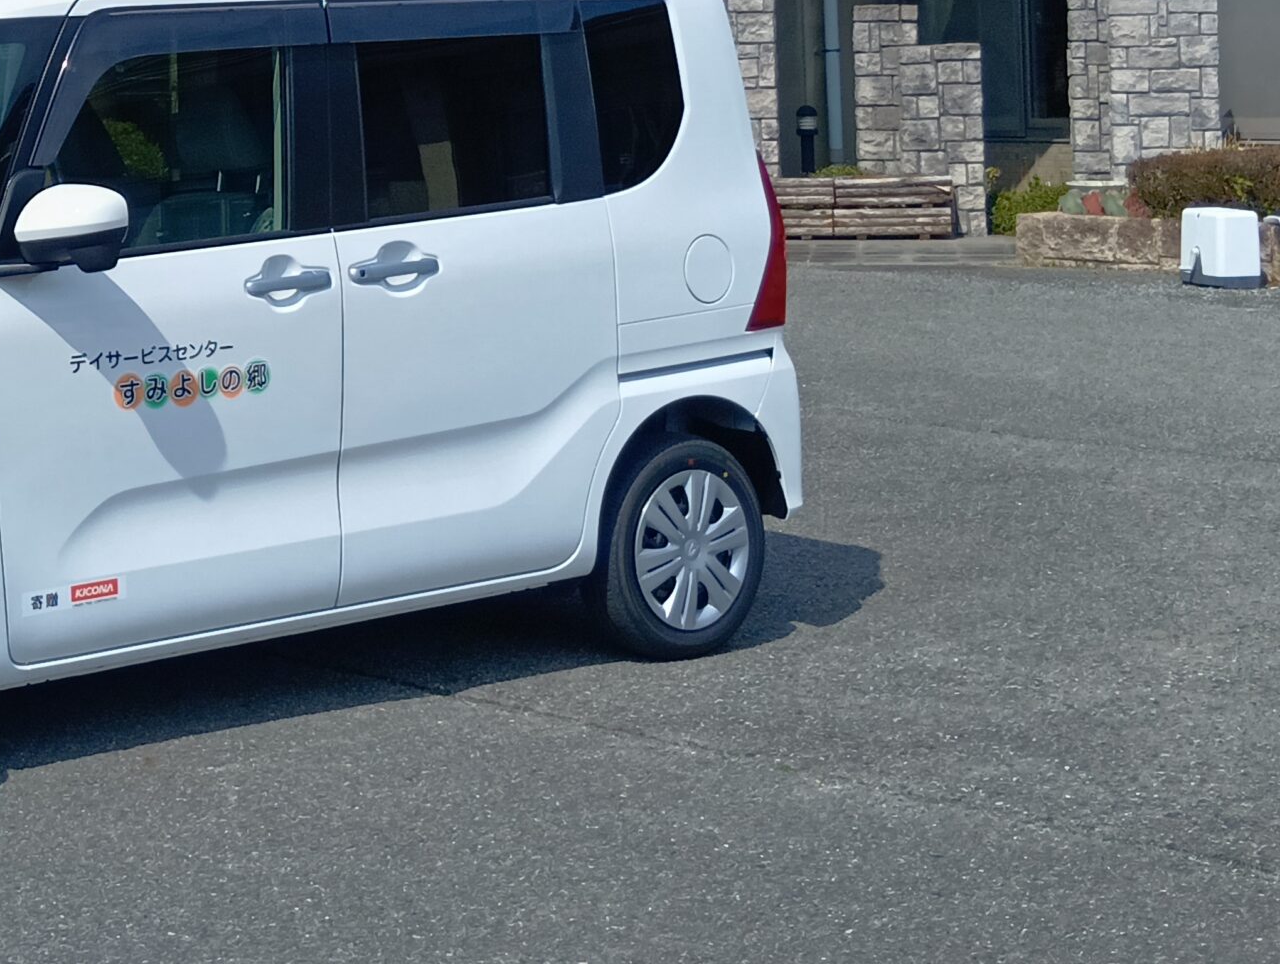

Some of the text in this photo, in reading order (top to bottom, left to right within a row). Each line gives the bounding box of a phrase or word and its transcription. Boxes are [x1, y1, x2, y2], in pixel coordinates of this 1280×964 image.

[70, 340, 233, 373] デイサービスセンター
[119, 362, 268, 407] すみよしの郷
